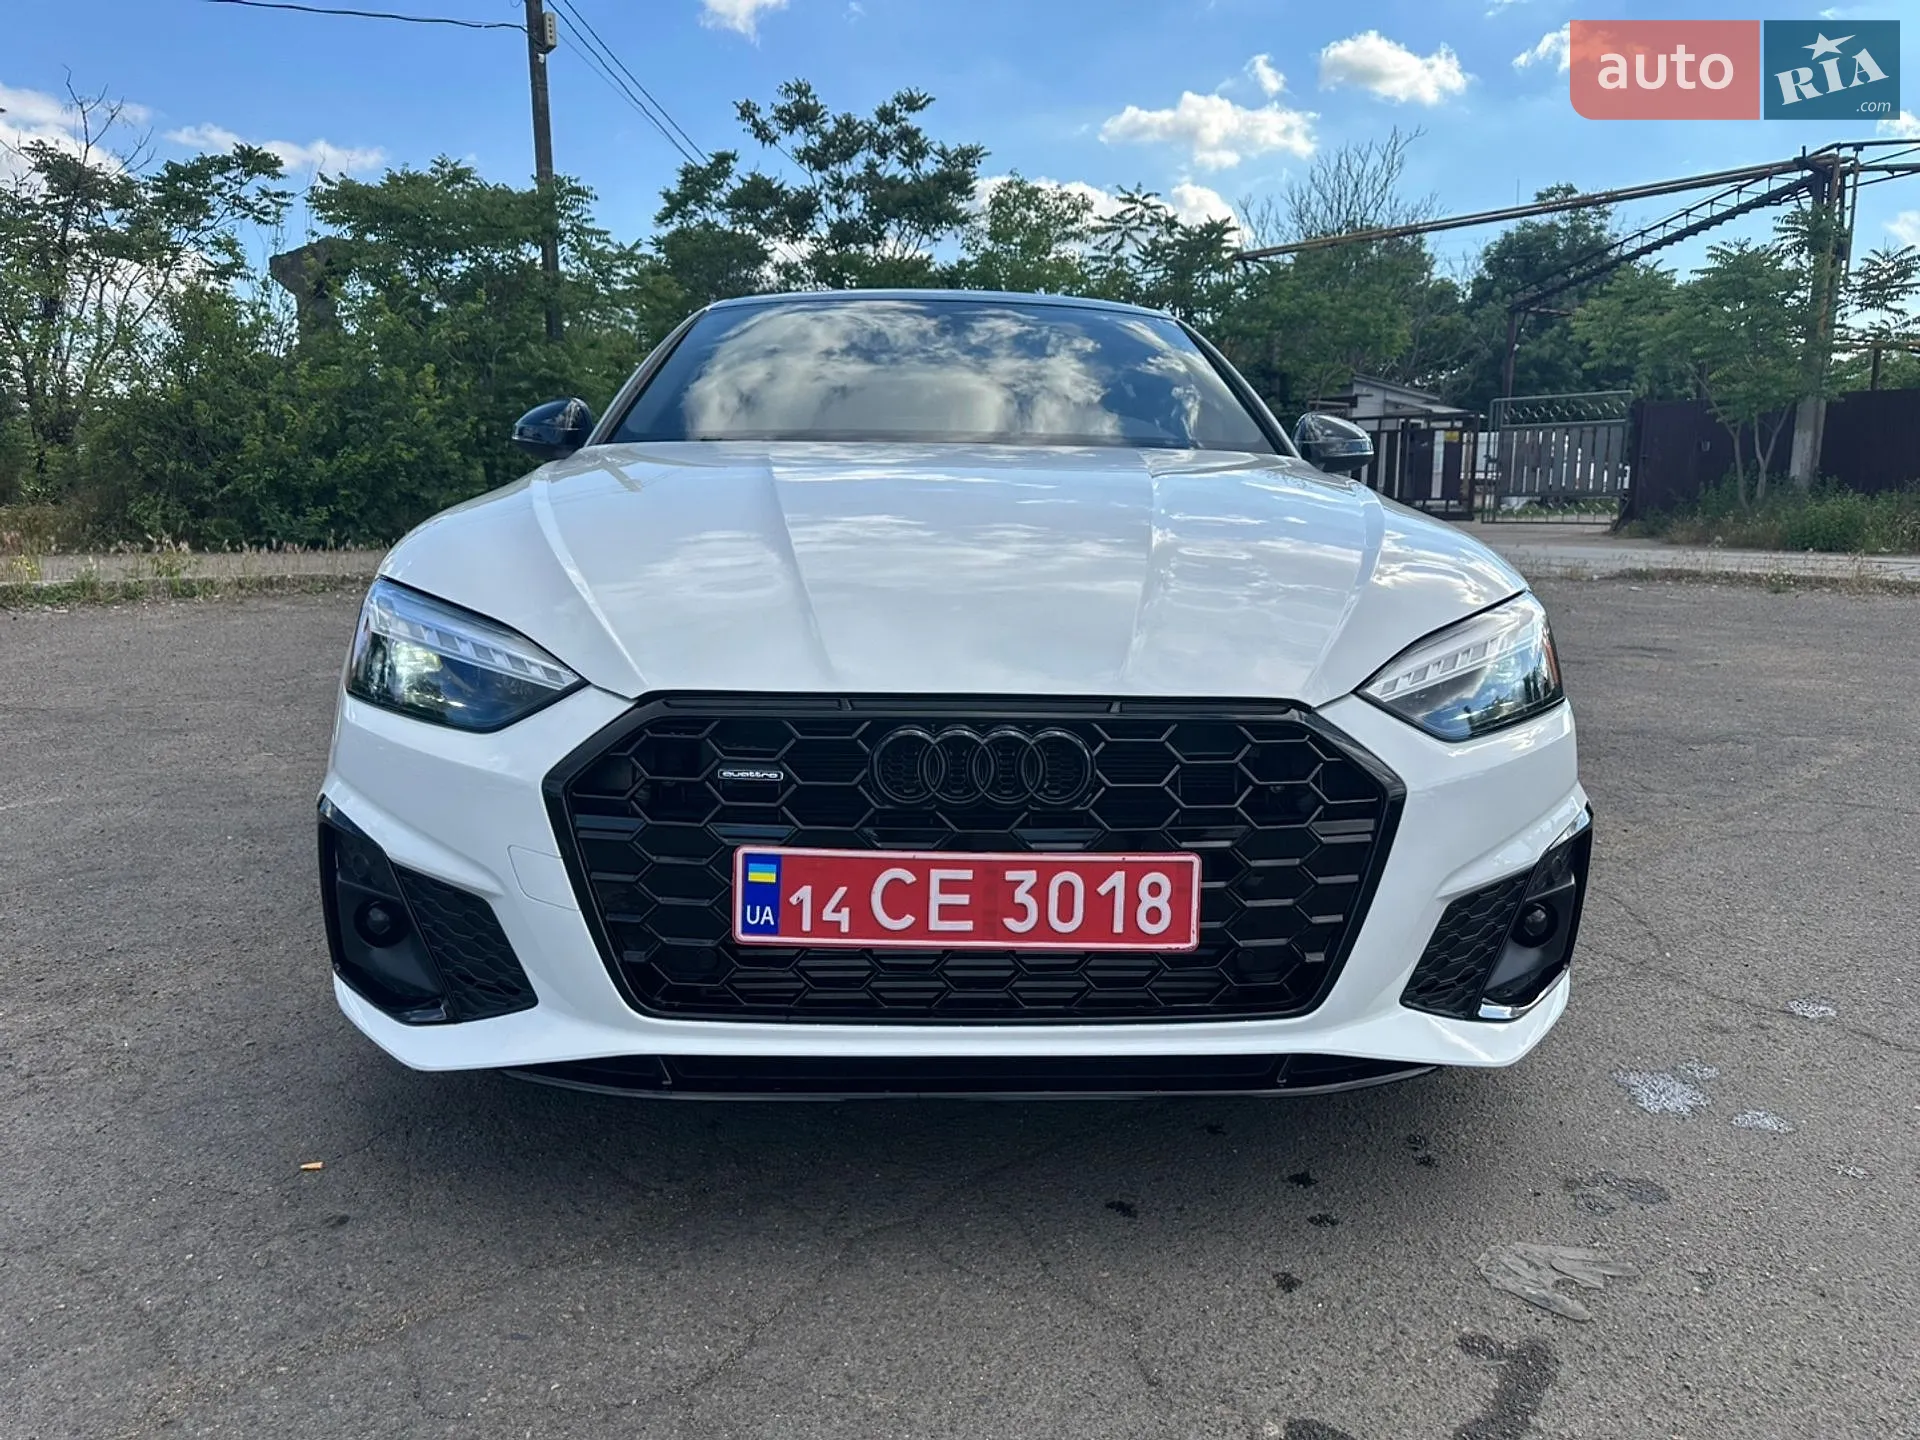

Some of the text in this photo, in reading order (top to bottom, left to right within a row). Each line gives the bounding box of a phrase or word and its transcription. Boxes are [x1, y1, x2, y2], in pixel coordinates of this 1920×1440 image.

[721, 770, 779, 779] quattro
[789, 868, 1172, 935] 14 CE 3018
[746, 905, 775, 926] UA
